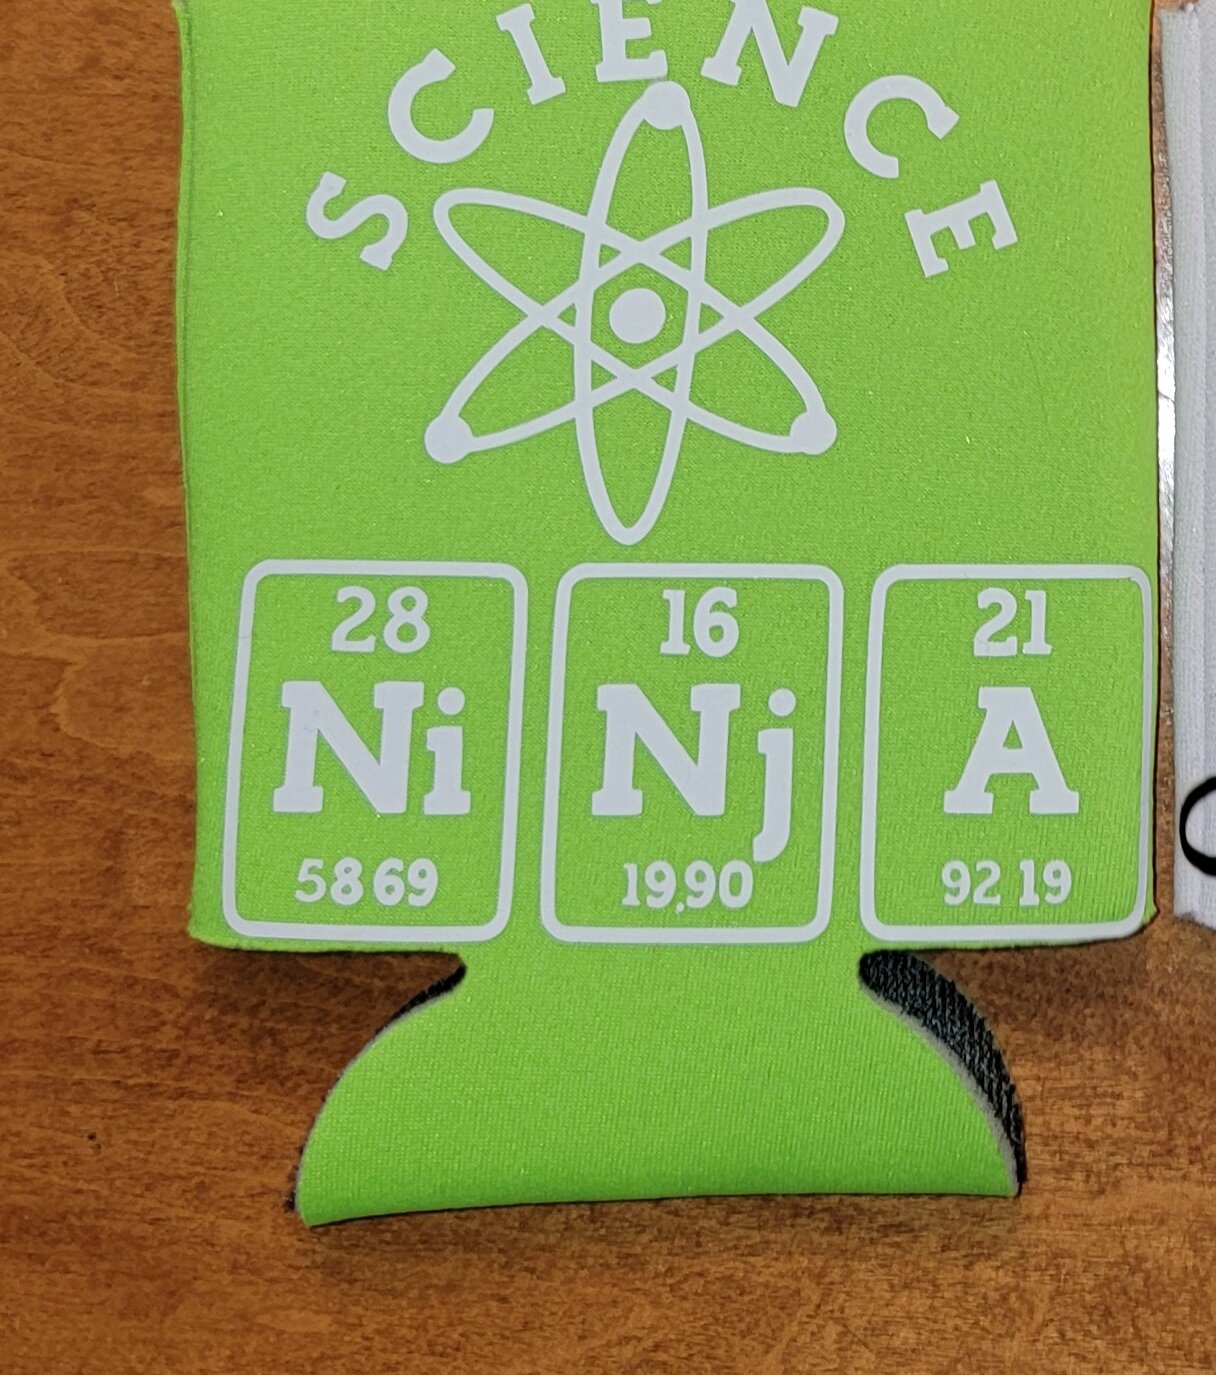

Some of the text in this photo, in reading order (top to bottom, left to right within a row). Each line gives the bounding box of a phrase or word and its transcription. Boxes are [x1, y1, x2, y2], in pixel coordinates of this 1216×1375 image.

[331, 586, 431, 655] 28
[659, 587, 739, 659] 16
[972, 587, 1053, 658] 21
[272, 680, 473, 816] Ni
[590, 682, 796, 864] Nj
[942, 686, 1081, 816] A
